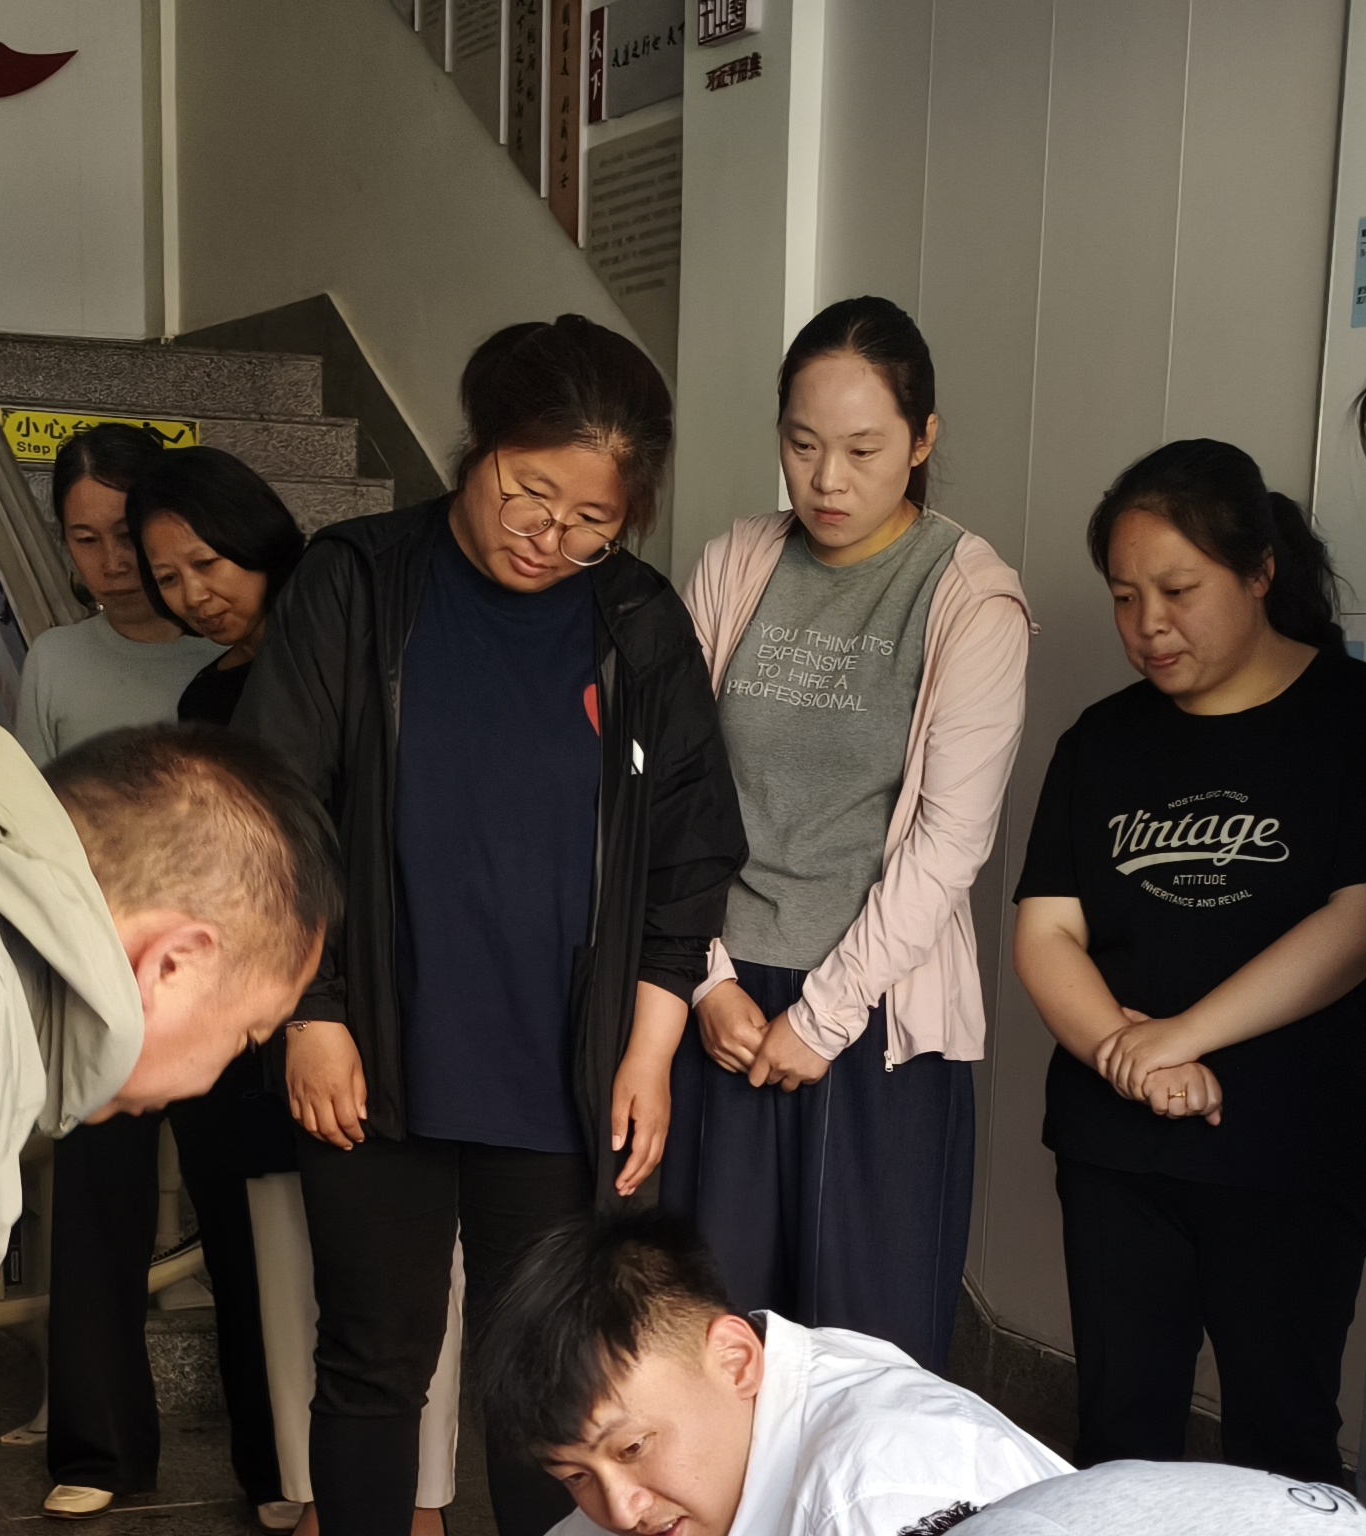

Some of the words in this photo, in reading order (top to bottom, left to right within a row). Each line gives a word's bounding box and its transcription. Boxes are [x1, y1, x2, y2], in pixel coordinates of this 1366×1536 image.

[16, 416, 108, 439] 小心台
[16, 441, 51, 456] Step
[759, 622, 798, 642] YOU
[804, 629, 860, 654] THINK
[756, 645, 860, 672] EXPENSIVE
[756, 662, 781, 679] TO
[788, 668, 833, 690] HIRE
[833, 674, 848, 690] A
[726, 679, 868, 712] PROFESSIONAL
[1167, 789, 1222, 810] NOSTALGIC
[1222, 789, 1249, 804] MOOD
[1108, 809, 1285, 866] Vintage
[1172, 873, 1227, 886] ATTITUDE
[1195, 898, 1216, 908] AND
